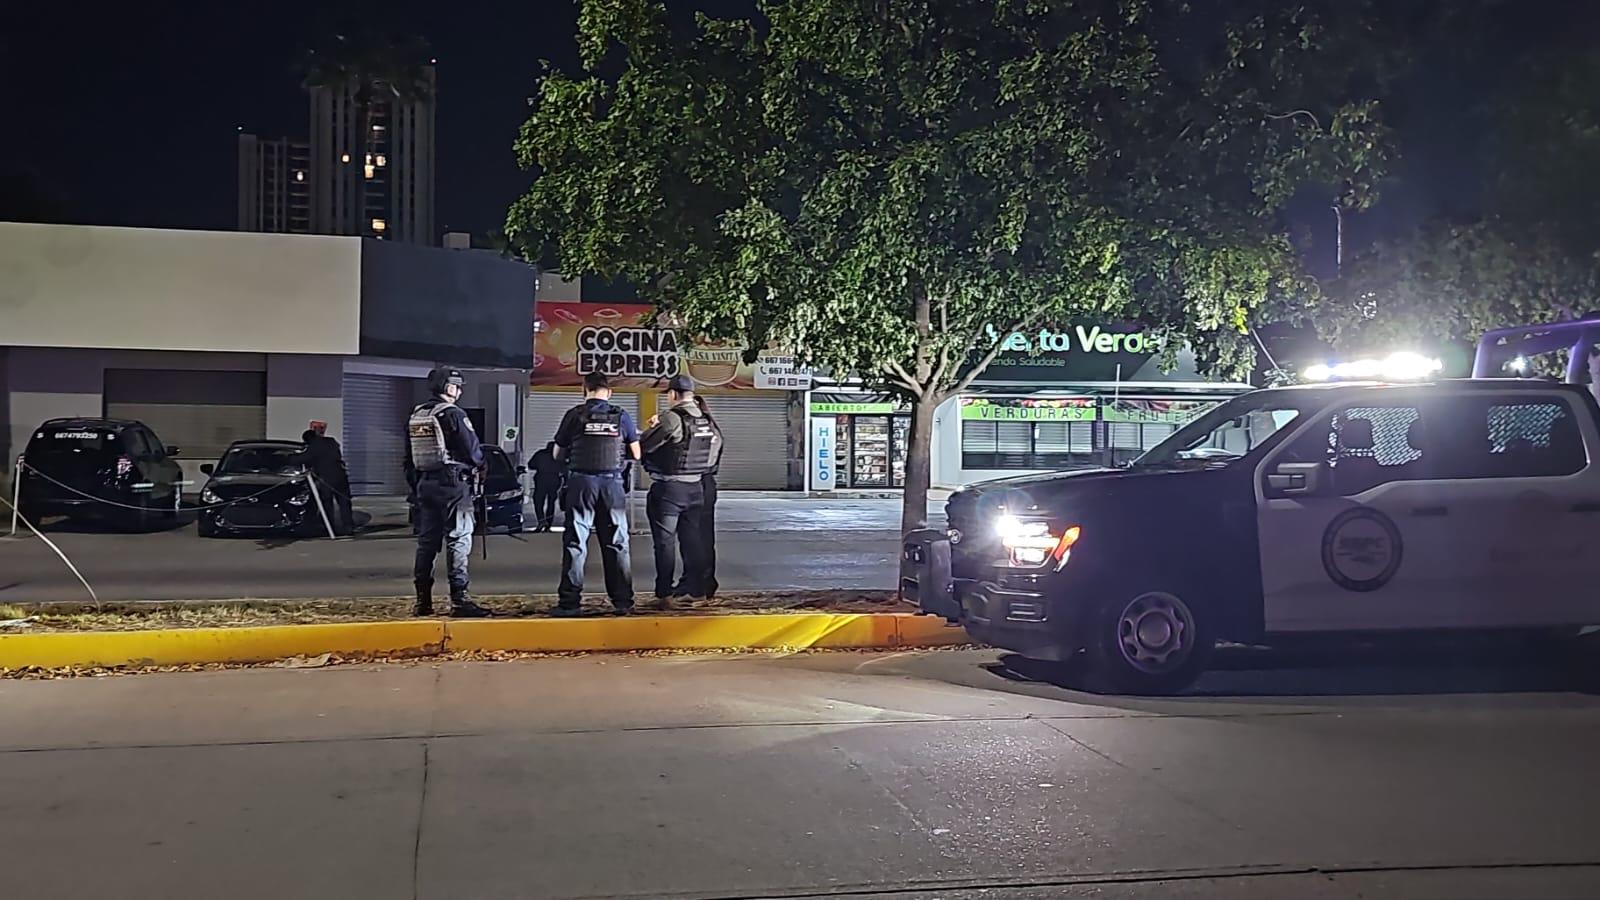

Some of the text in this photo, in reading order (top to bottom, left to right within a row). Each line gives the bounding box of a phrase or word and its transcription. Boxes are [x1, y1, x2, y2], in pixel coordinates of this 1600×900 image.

[578, 328, 677, 352] COCINA
[578, 352, 679, 378] EXPRESS
[1018, 357, 1066, 367] Saludable
[980, 408, 1083, 420] VERDURAS
[818, 426, 829, 481] HIELO
